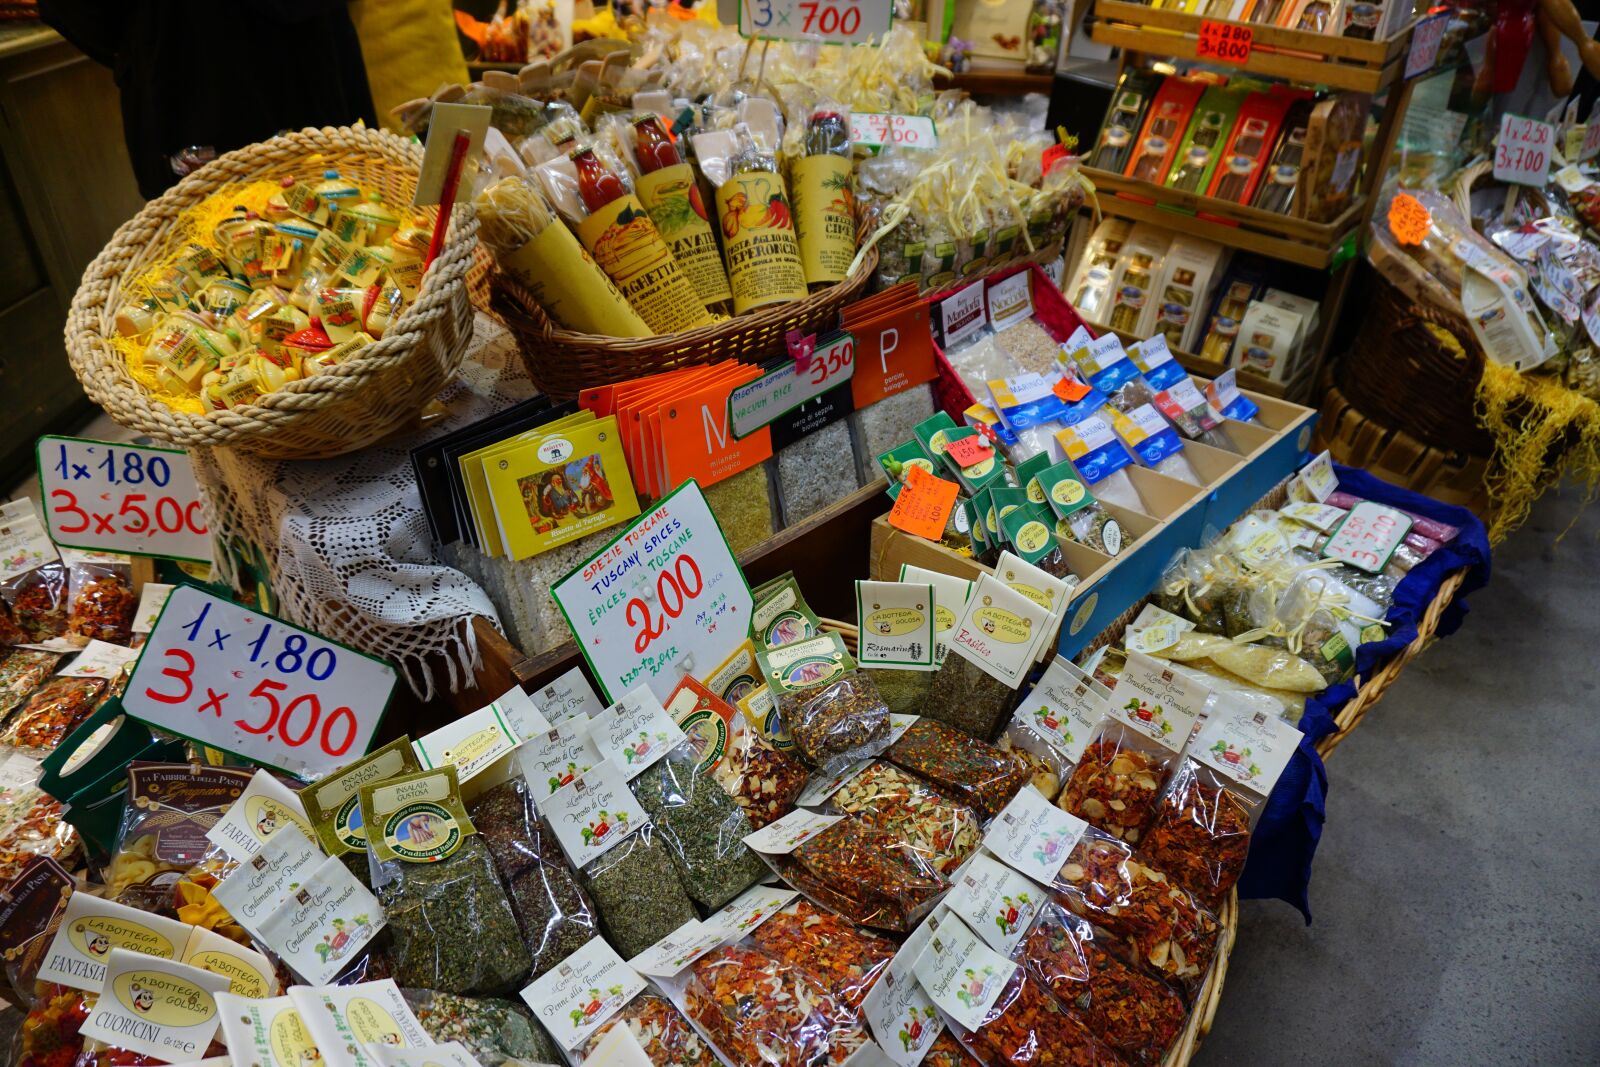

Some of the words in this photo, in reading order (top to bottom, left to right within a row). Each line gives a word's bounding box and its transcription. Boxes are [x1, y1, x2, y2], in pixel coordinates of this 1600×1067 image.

[880, 328, 899, 373] P
[733, 382, 763, 402] RISOTTO
[773, 383, 793, 401] RICE
[1009, 378, 1044, 394] MARINO
[701, 397, 730, 455] M
[98, 449, 171, 487] 1,80
[709, 451, 741, 468] milanese
[711, 460, 741, 477] biologico
[583, 513, 606, 526] Tartufo
[582, 544, 623, 582] SPEZIE
[624, 507, 669, 547] TOSCANE
[591, 550, 642, 595] TUSCANY
[644, 518, 681, 553] SPICES
[647, 527, 693, 572] TOSCANE
[872, 614, 882, 622] LA
[882, 610, 912, 620] BOTTEGA
[895, 617, 921, 625] GOLOSA
[992, 611, 1023, 627] BOTTEGA
[182, 602, 212, 641] 1
[247, 623, 336, 681] 1,80
[956, 628, 992, 657] Basilico
[1001, 624, 1027, 637] GOLOSA
[145, 648, 195, 704] 3
[233, 678, 357, 757] 5,00
[1124, 672, 1154, 695] Bruschetta
[1162, 694, 1196, 718] Pomodoro
[218, 775, 244, 787] PASTA
[341, 763, 378, 786] INSALATA
[395, 781, 429, 795] INSALATA
[397, 787, 429, 802] GUSTOSA
[397, 846, 441, 858] Tradizioni
[439, 830, 458, 852] Italiane
[242, 884, 276, 918] Condimento
[282, 849, 313, 881] Pomodori
[88, 918, 105, 931] LA
[105, 924, 159, 945] BOTTEGA
[285, 921, 319, 955] Condimento
[318, 912, 328, 927] per
[326, 885, 356, 917] Pomodori
[121, 940, 168, 958] GOLOSA
[49, 954, 107, 982] FANTASIA
[204, 954, 219, 969] LA
[219, 961, 261, 987] BOTTEGA
[131, 973, 148, 985] LA
[148, 977, 201, 998] BOTTEGA
[542, 994, 570, 1019] Penne
[570, 984, 584, 1001] alla
[584, 959, 618, 988] Fiorentina
[166, 994, 209, 1015] GOLOSA
[95, 1010, 161, 1043] CUORICINI
